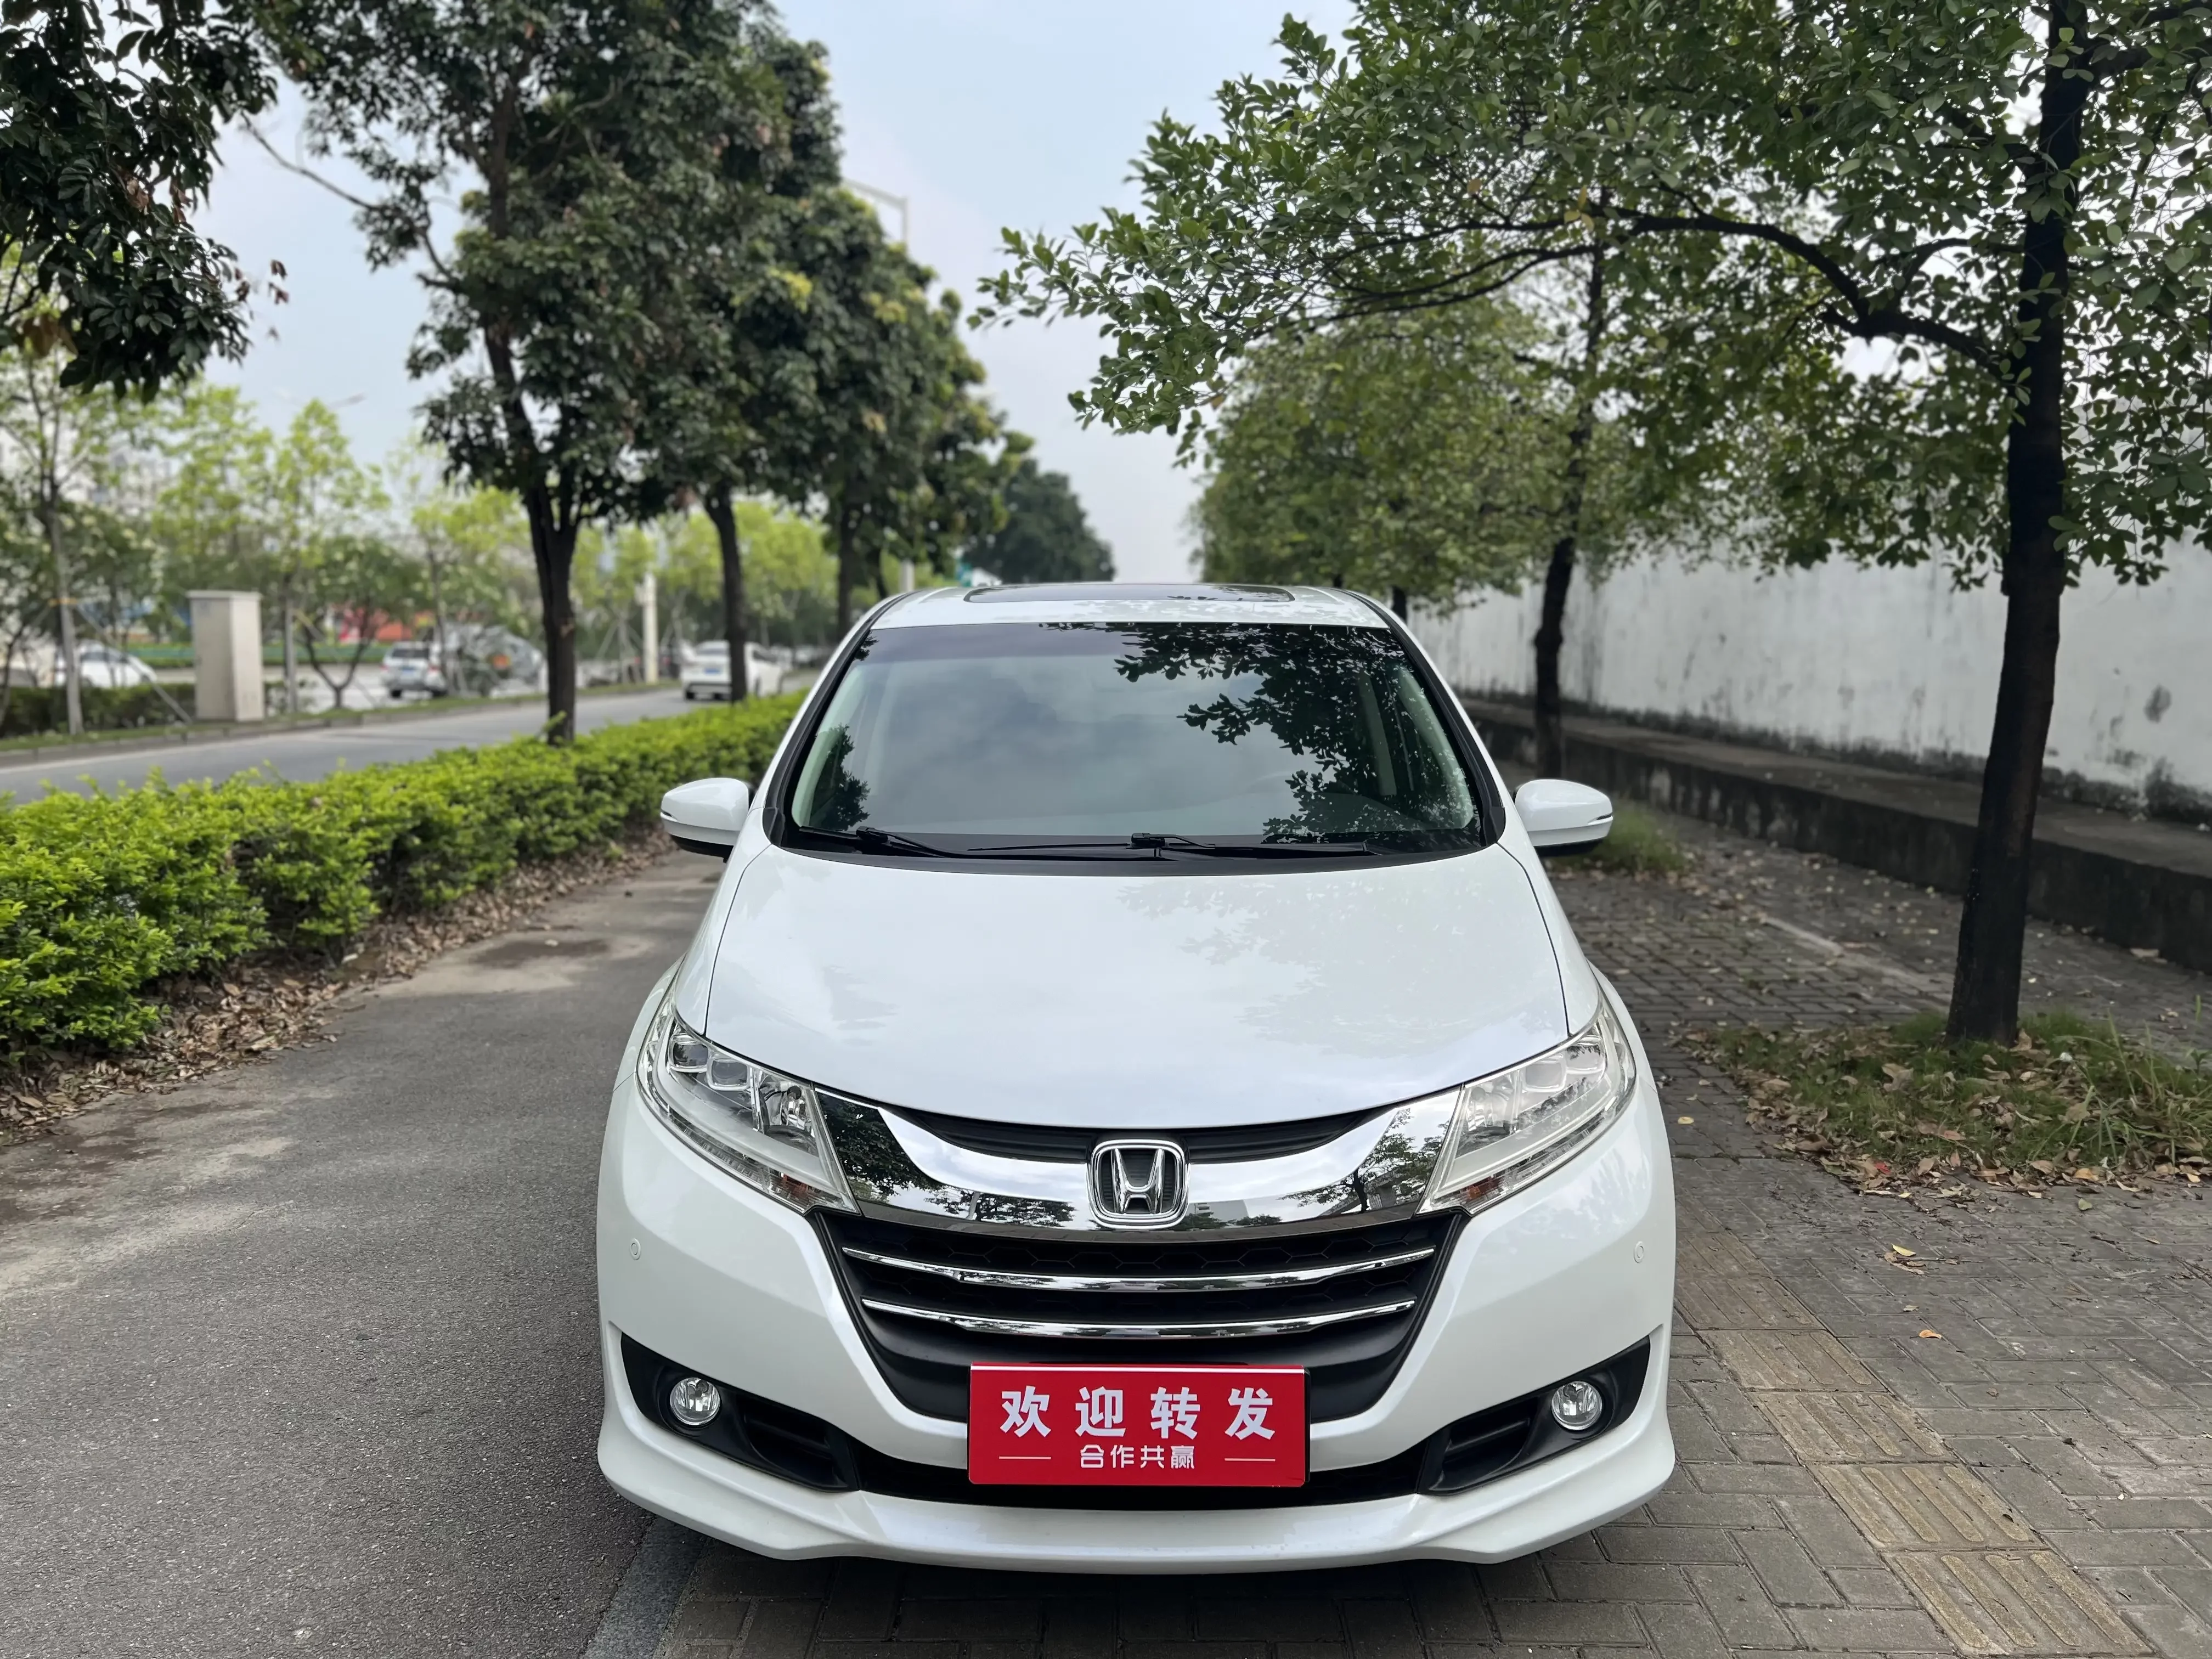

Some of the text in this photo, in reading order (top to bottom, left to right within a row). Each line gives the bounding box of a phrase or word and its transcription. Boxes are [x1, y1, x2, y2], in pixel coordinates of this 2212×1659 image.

[1111, 1148, 1166, 1214] H
[1000, 1385, 1276, 1440] 欢迎转发
[1080, 1444, 1195, 1469] 合作共赢
